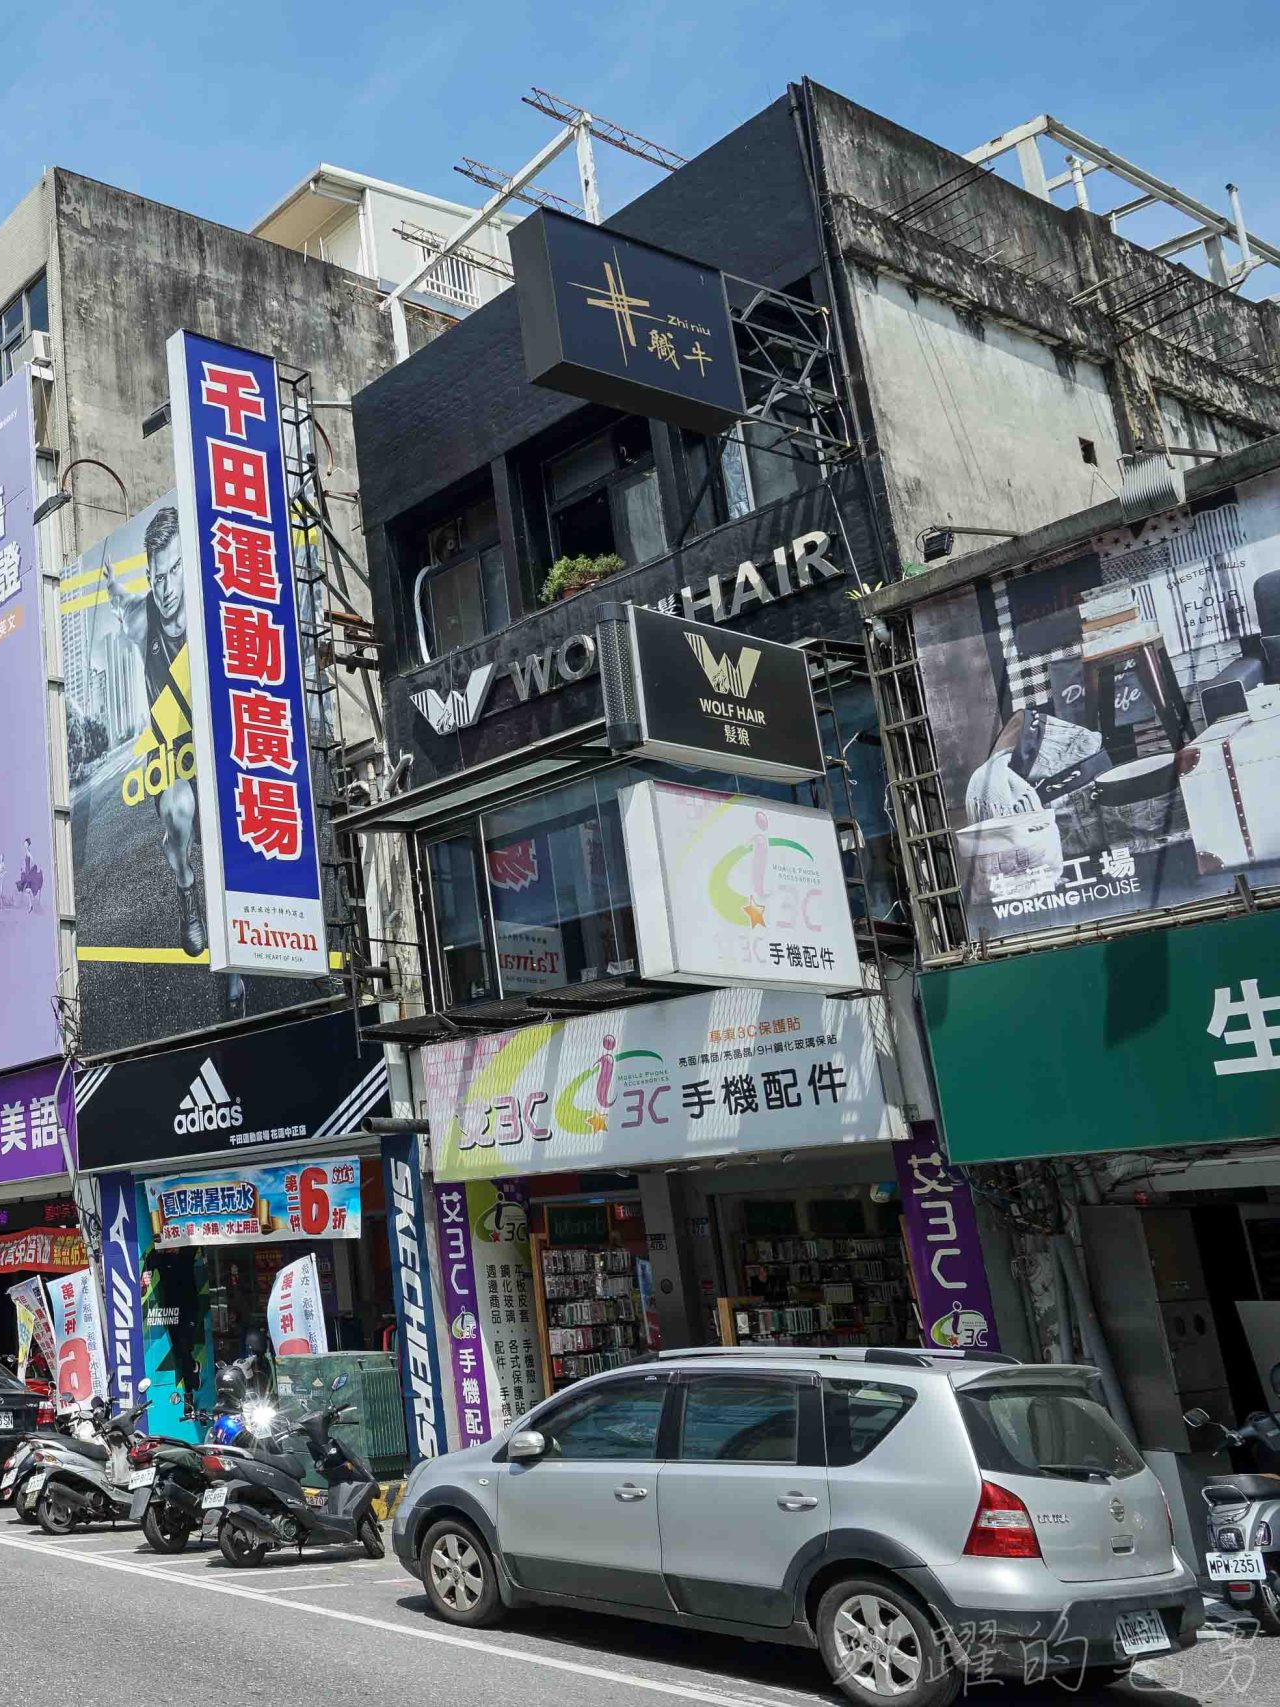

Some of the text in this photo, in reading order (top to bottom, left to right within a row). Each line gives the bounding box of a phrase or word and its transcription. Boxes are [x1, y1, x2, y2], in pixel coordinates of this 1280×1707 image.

[648, 329, 712, 378] 職牛
[681, 530, 841, 623] HAIR
[200, 361, 303, 861] 千田運動廣場
[699, 697, 766, 725] WOLF HAIR
[992, 877, 1142, 920] WORKING HOUSE
[232, 919, 318, 951] Taiwan
[769, 942, 836, 971] 手機配件
[682, 1062, 848, 1120] 手機配件
[173, 1104, 244, 1135] adidas
[332, 1165, 355, 1185] SALE
[161, 1182, 255, 1218] 夏日消暑玩水
[299, 1166, 330, 1236] 6
[146, 1316, 179, 1326] RUNNING
[147, 1307, 180, 1317] MIZUNO
[390, 1158, 439, 1459] SKECHERS
